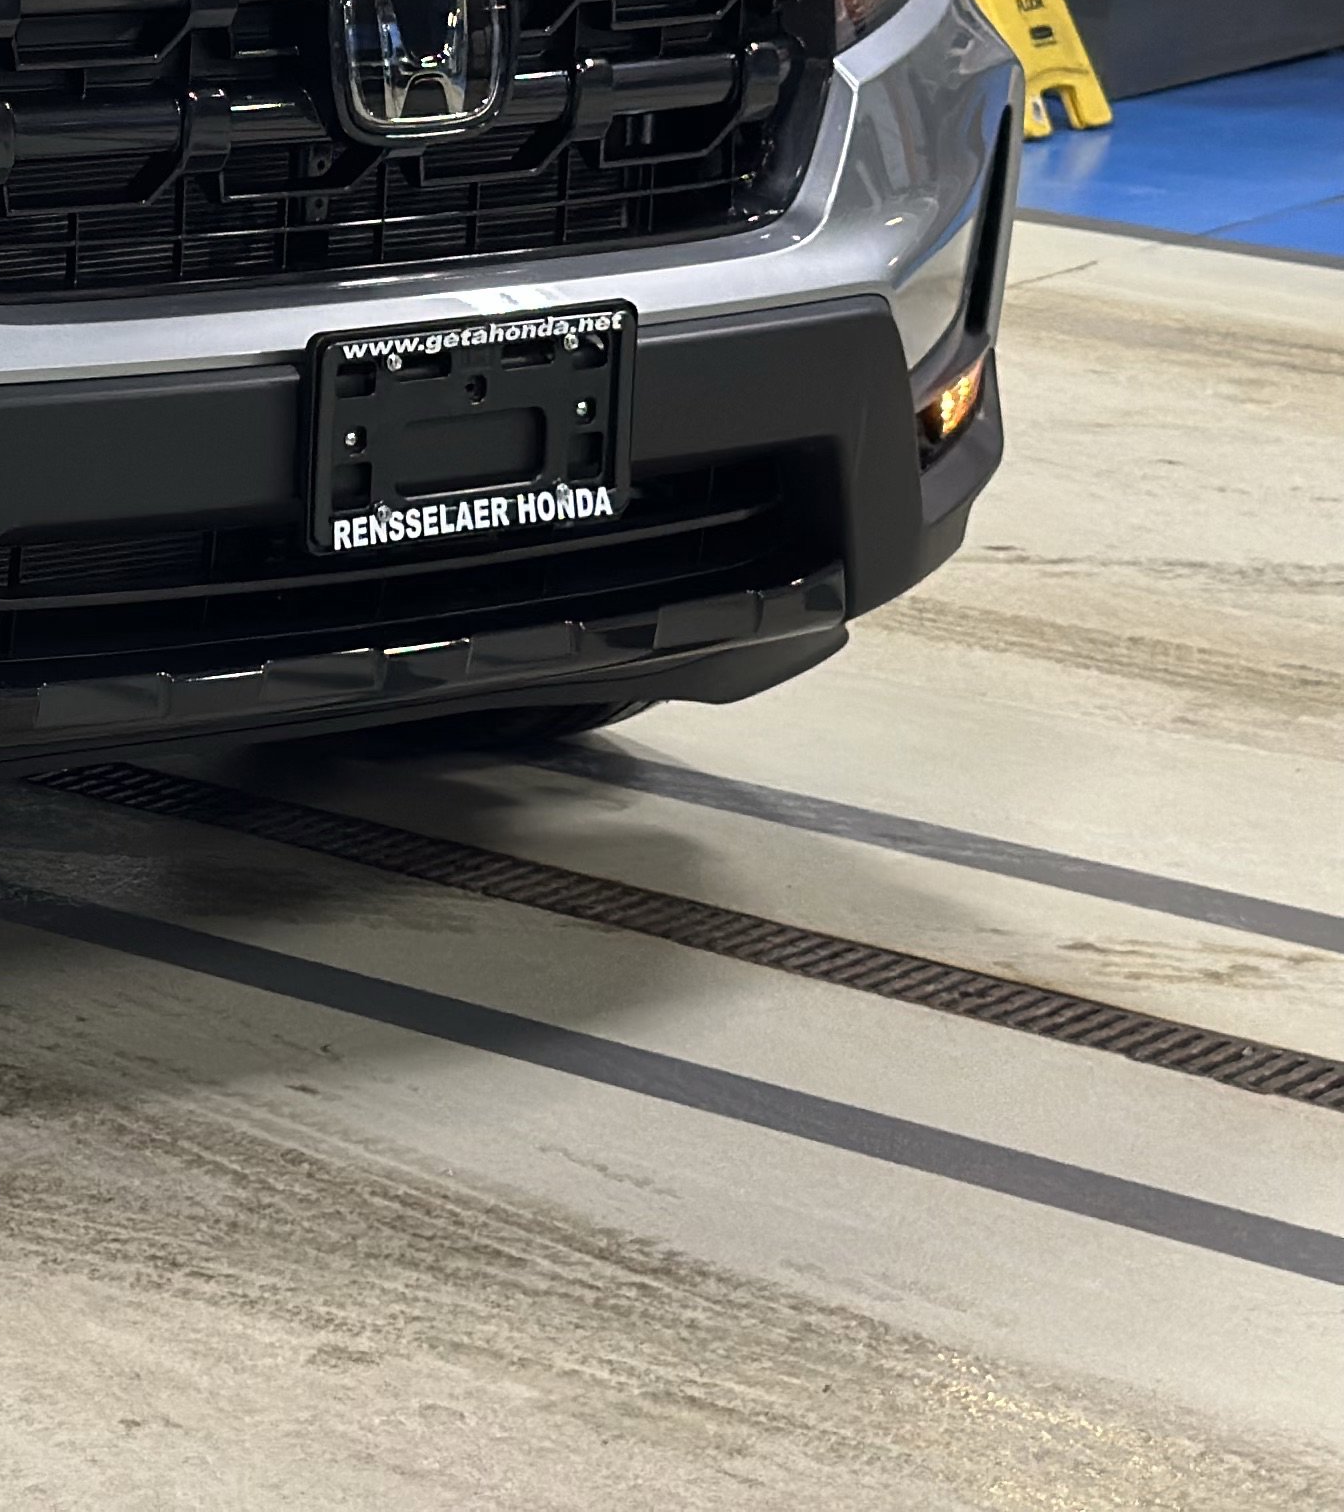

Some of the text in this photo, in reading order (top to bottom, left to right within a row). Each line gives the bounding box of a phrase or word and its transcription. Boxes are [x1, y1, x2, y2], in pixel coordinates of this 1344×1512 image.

[342, 311, 623, 360] www.getahonda.net
[333, 485, 614, 551] RENSSELAER HONDA
